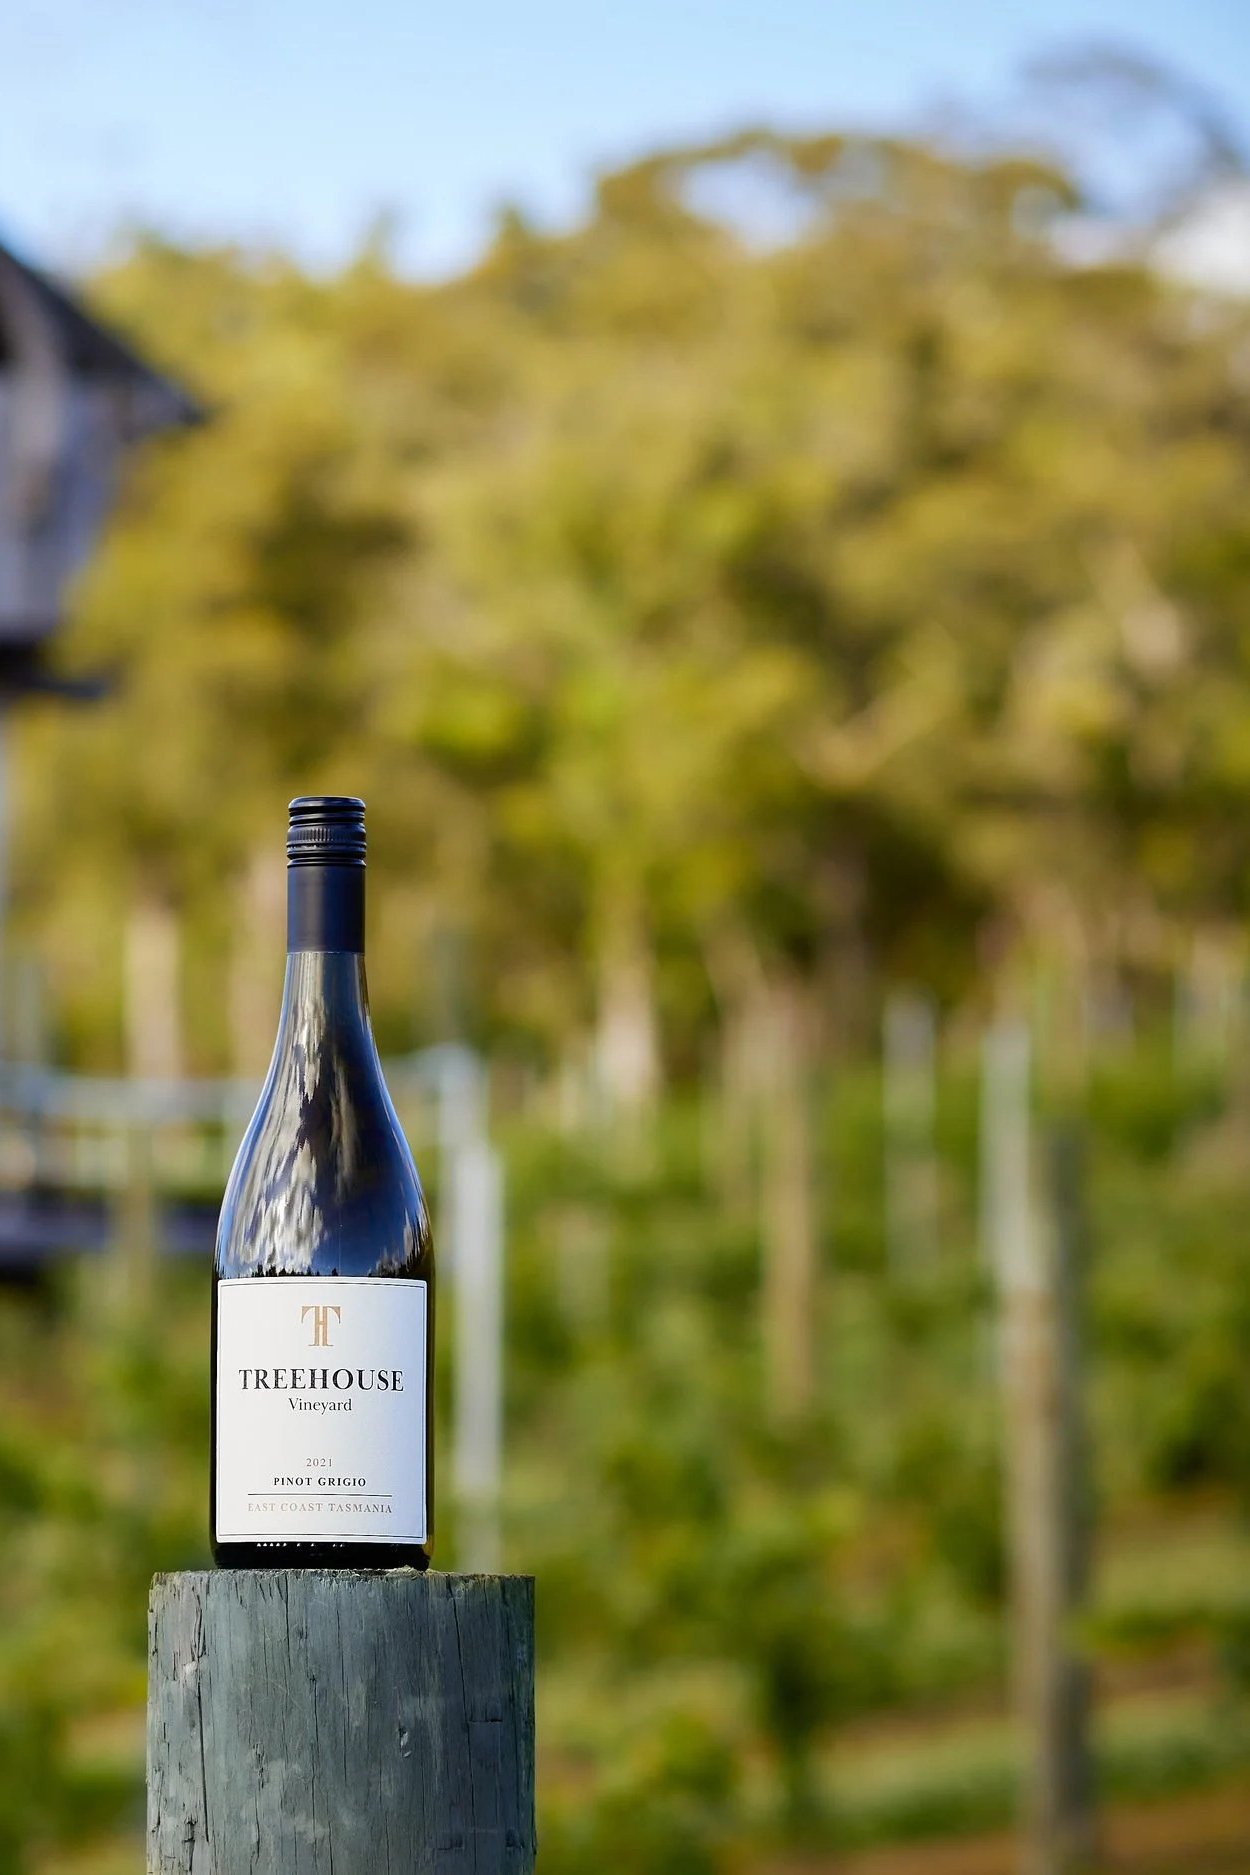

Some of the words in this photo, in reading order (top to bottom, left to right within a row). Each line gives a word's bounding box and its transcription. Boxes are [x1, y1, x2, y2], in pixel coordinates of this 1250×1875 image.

[238, 1368, 404, 1392] TREEHOUSE
[288, 1397, 352, 1415] Vineyard
[305, 1457, 333, 1468] 2021
[273, 1476, 313, 1487] PINOT
[317, 1477, 367, 1488] GRIGIO
[247, 1502, 276, 1512] EAST
[280, 1502, 324, 1513] COAST
[327, 1503, 393, 1514] TASMANIA
